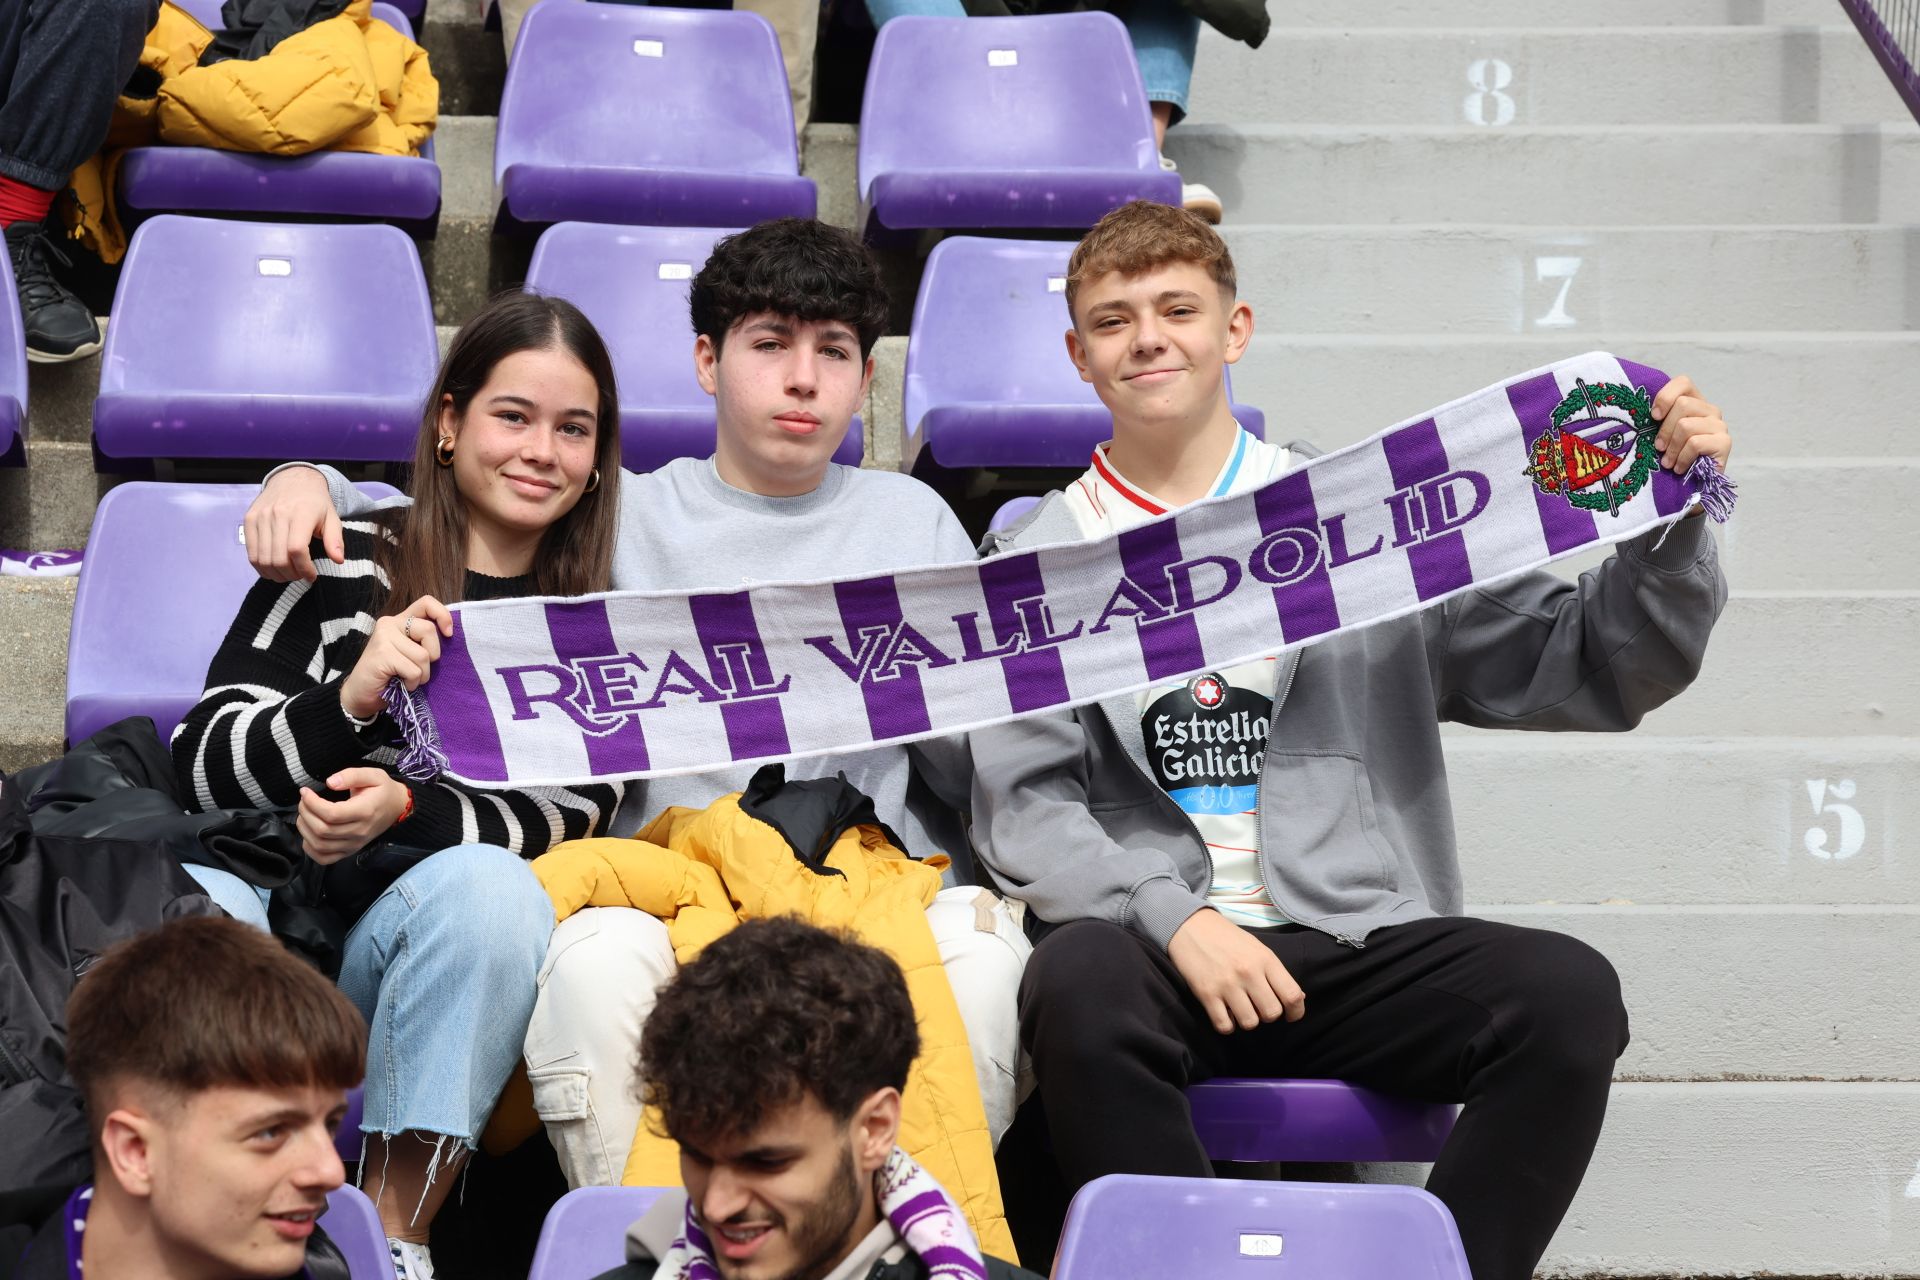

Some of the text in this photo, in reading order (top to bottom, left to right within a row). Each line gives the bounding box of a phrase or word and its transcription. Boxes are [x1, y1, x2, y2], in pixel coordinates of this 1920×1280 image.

[1463, 58, 1516, 127] 8
[1535, 256, 1583, 326] 7
[495, 471, 1490, 735] REAL VALLADOLID
[1154, 711, 1270, 749] Estrella
[1804, 779, 1866, 860] 5
